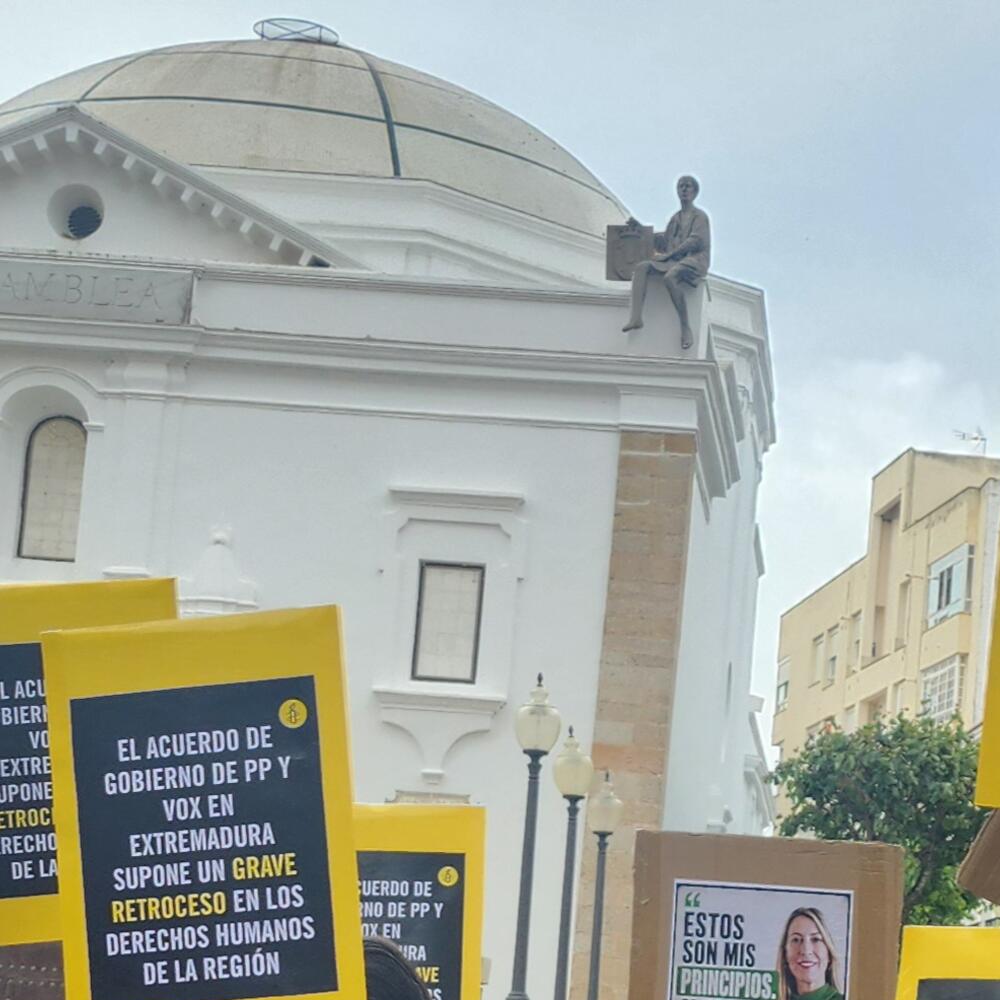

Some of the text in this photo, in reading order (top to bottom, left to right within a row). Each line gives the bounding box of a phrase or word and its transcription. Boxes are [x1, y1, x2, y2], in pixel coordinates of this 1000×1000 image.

[117, 725, 273, 762] EL ACUERDO DE
[104, 756, 291, 795] GOBIERNO DE PP Y
[162, 793, 235, 822] VOX EN
[129, 821, 276, 857] EXTREMADURA
[11, 858, 58, 880] DE LA
[113, 852, 297, 891] SUPONE UN GRAVE
[111, 884, 304, 923] RETROCESO EN LOS
[359, 880, 433, 897] UERDO DE
[388, 902, 406, 918] DE
[410, 902, 430, 918] PP
[434, 903, 443, 919] Y
[684, 911, 745, 940] ESTOS
[105, 916, 316, 956] DERECHOS HUMANOS
[383, 923, 401, 939] EN
[143, 948, 281, 985] DE LA REGIÓN
[682, 940, 756, 967] SON MIS
[680, 967, 777, 1000] PRINCIPIOS.
